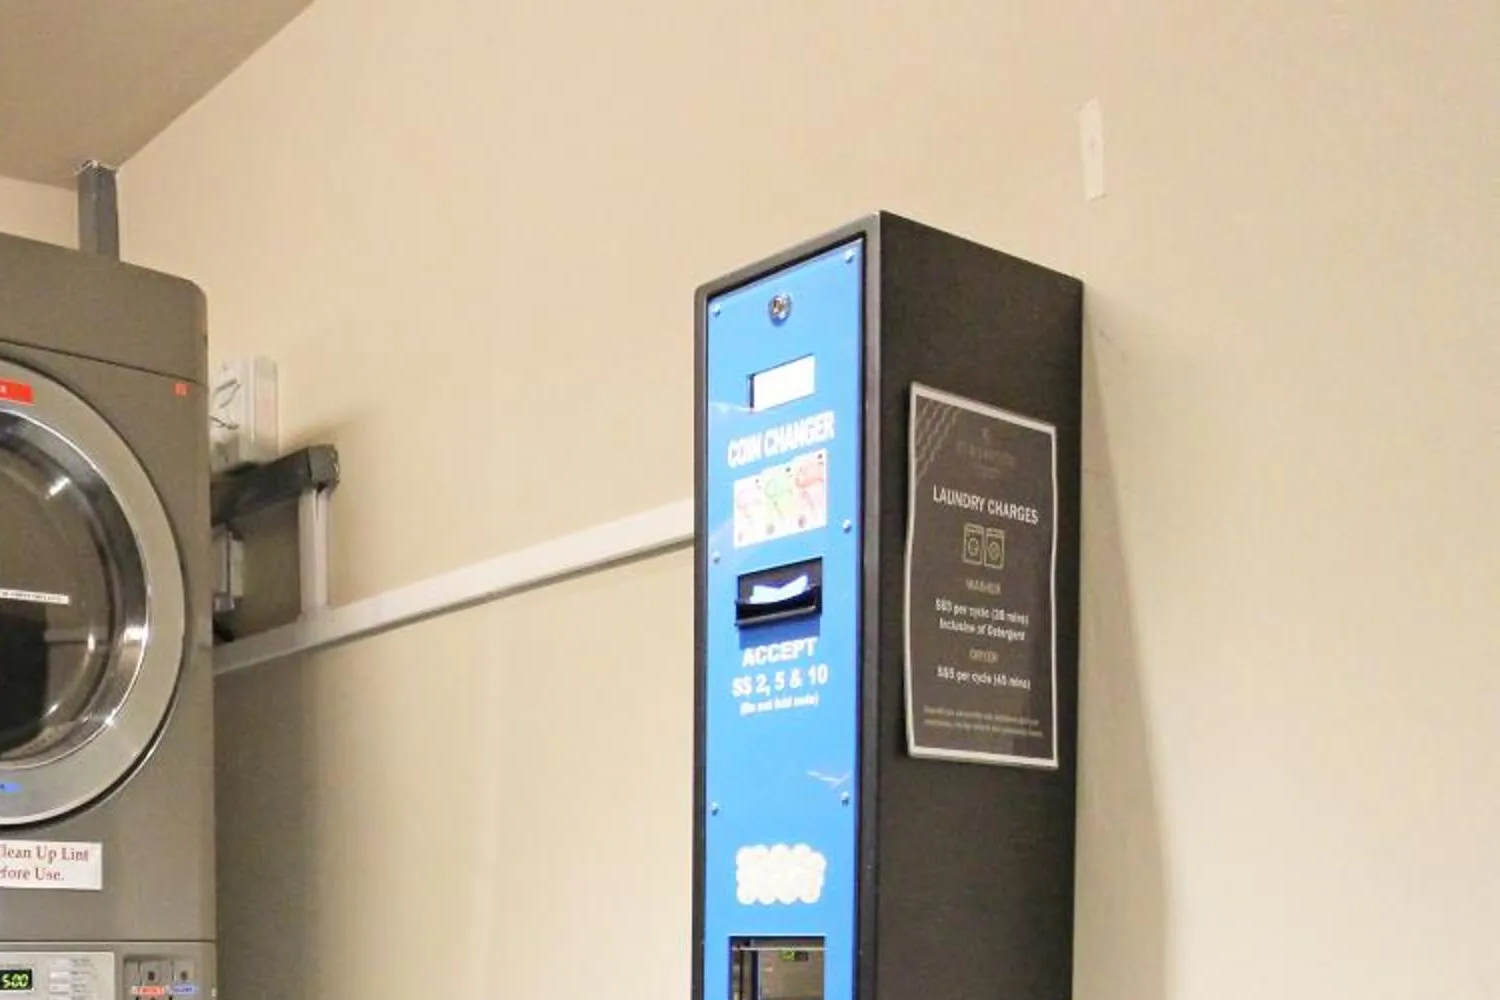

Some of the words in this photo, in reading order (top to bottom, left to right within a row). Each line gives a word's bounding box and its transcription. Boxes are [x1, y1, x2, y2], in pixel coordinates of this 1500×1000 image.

[728, 432, 762, 468] COIN
[764, 410, 835, 457] CHANGER
[933, 484, 986, 513] LAUNDRY
[987, 499, 1039, 525] CHARGES
[742, 637, 818, 667] ACCEPT
[774, 671, 785, 691] 5
[789, 668, 802, 689] &
[808, 663, 829, 685] 10
[36, 844, 57, 864] Up
[61, 846, 89, 861] Lint
[35, 866, 65, 881] Use.
